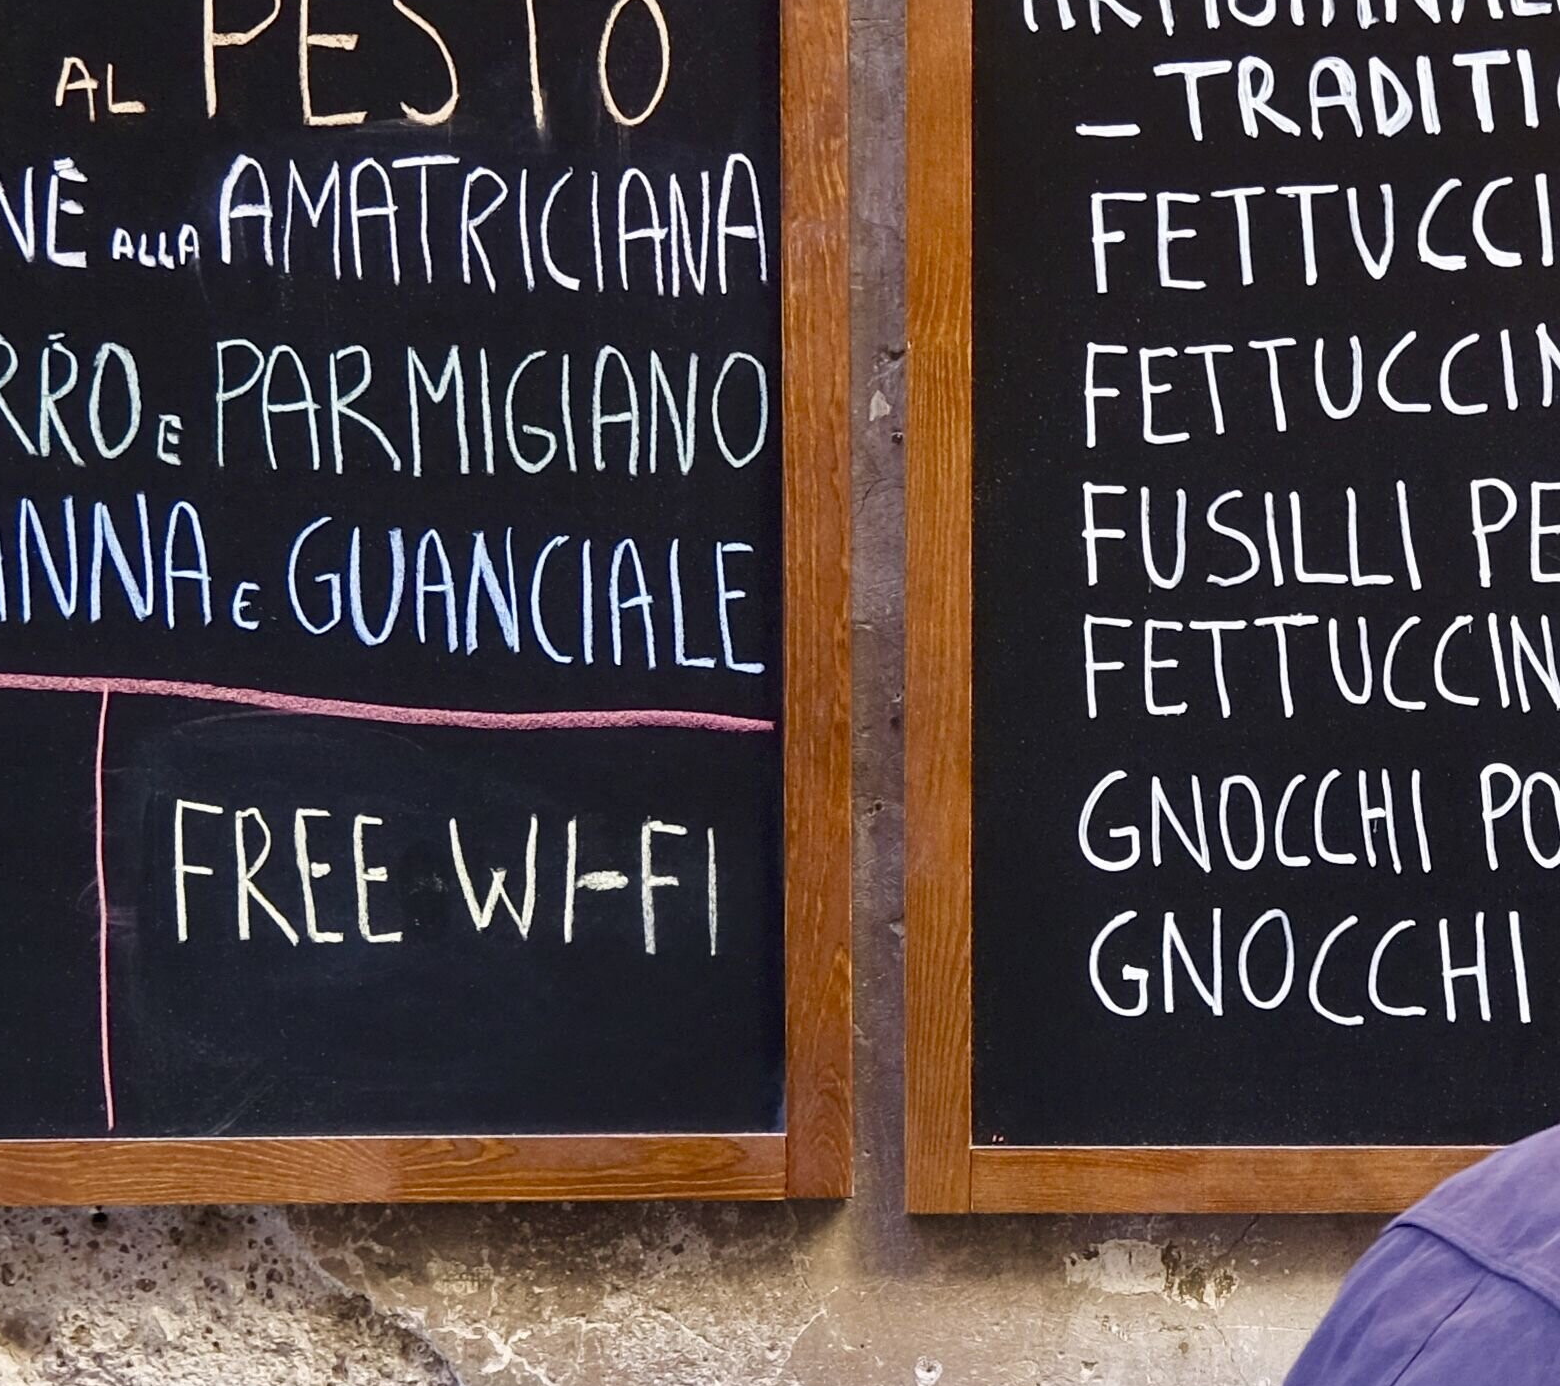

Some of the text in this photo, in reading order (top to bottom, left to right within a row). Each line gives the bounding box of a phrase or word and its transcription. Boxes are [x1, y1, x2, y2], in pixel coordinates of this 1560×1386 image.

[55, 57, 145, 121] AL
[112, 224, 199, 269] ALLA
[219, 153, 767, 297] AMATRICIANA
[216, 339, 768, 477] PARMIGIANO
[287, 517, 764, 674] GUANCIALE
[1082, 480, 1422, 590] FUSILLI
[174, 799, 717, 955] FREE WI-FI
[1078, 769, 1431, 874] GNOCCHI
[1089, 908, 1531, 1026] GNOCCHI
